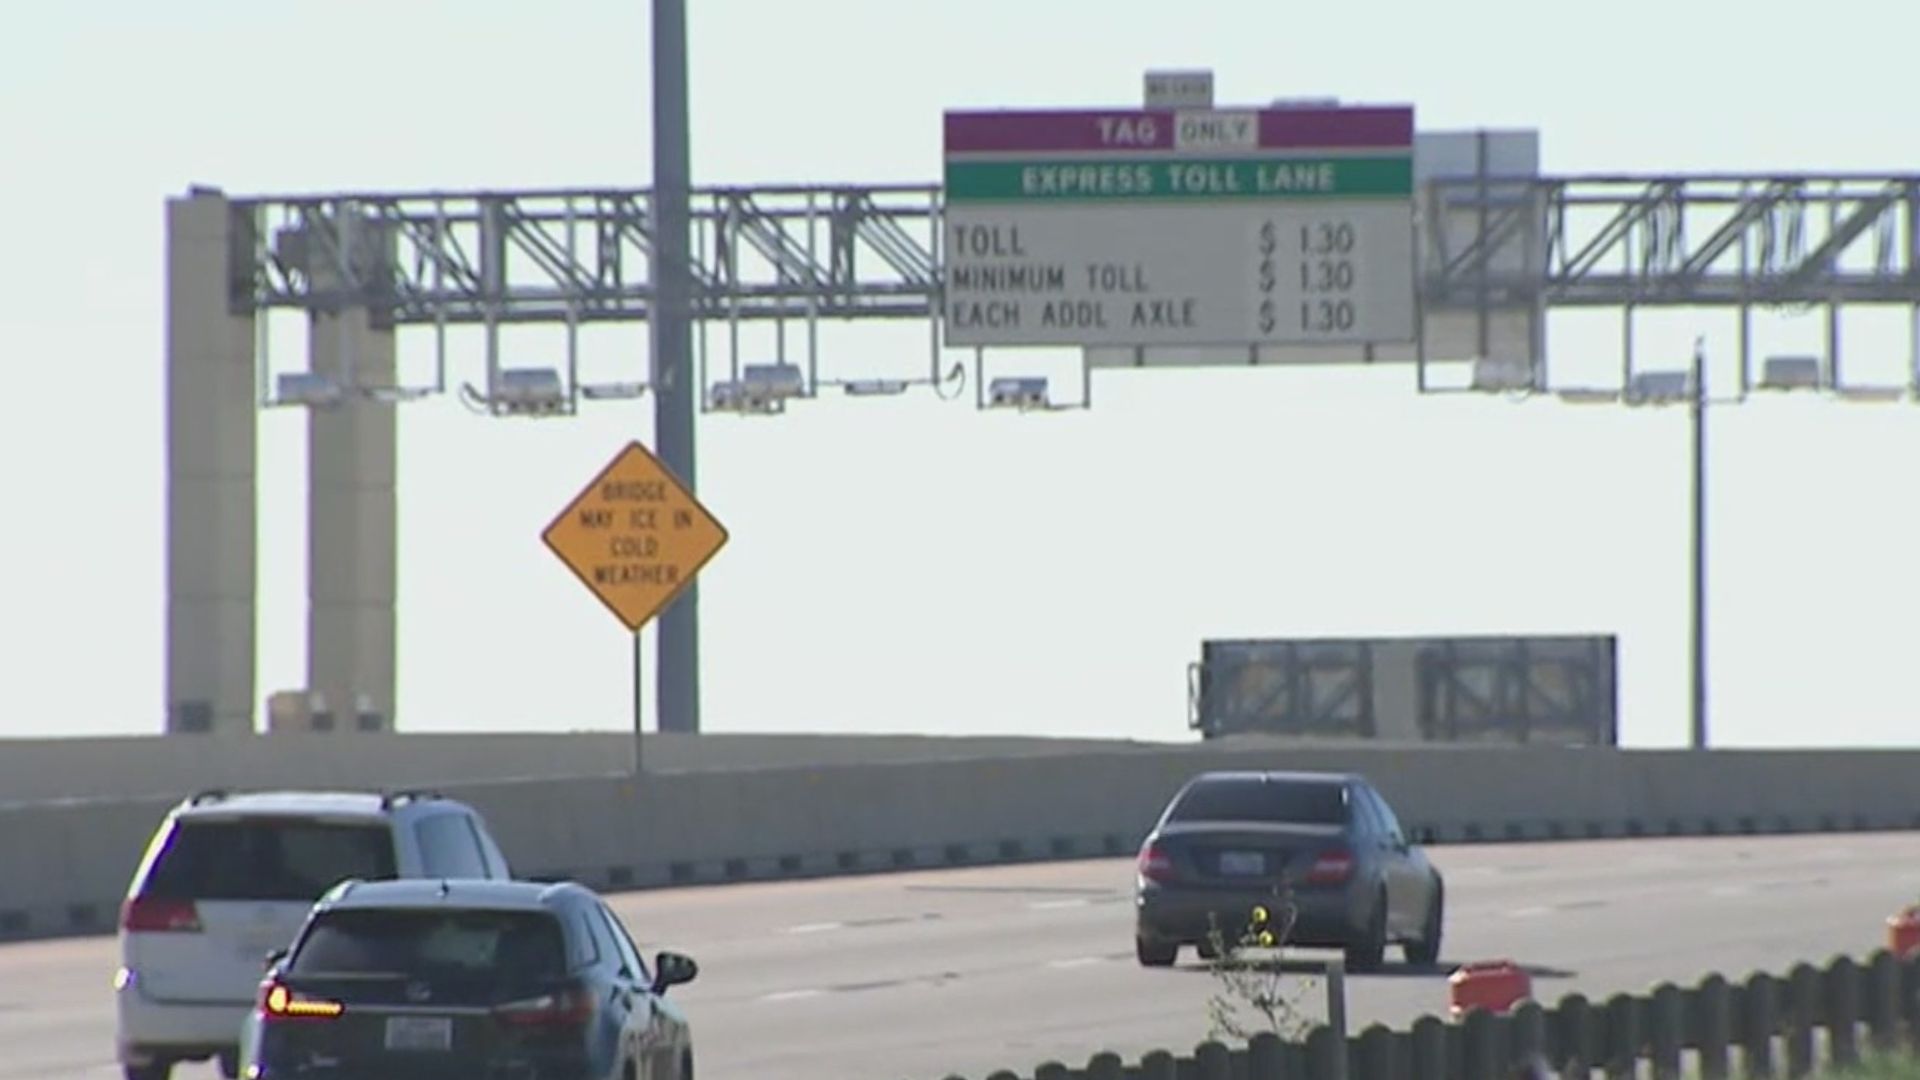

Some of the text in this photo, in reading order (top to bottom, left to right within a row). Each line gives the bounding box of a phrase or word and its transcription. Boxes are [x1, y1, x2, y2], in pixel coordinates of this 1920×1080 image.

[1099, 118, 1248, 144] TAG ONLY
[1022, 163, 1335, 195] EXPRESS TOLL LANE
[953, 221, 1356, 256] TOLL $ 1.30
[953, 259, 1355, 293] MINIMUM TOLL $ 1.30
[953, 300, 1355, 334] EACH ADDL AXLE $ 1.30
[603, 482, 667, 501] BRIDGE
[580, 508, 693, 529] MAY ICE IN
[611, 536, 659, 557] COLD
[595, 563, 679, 585] WEATHER
